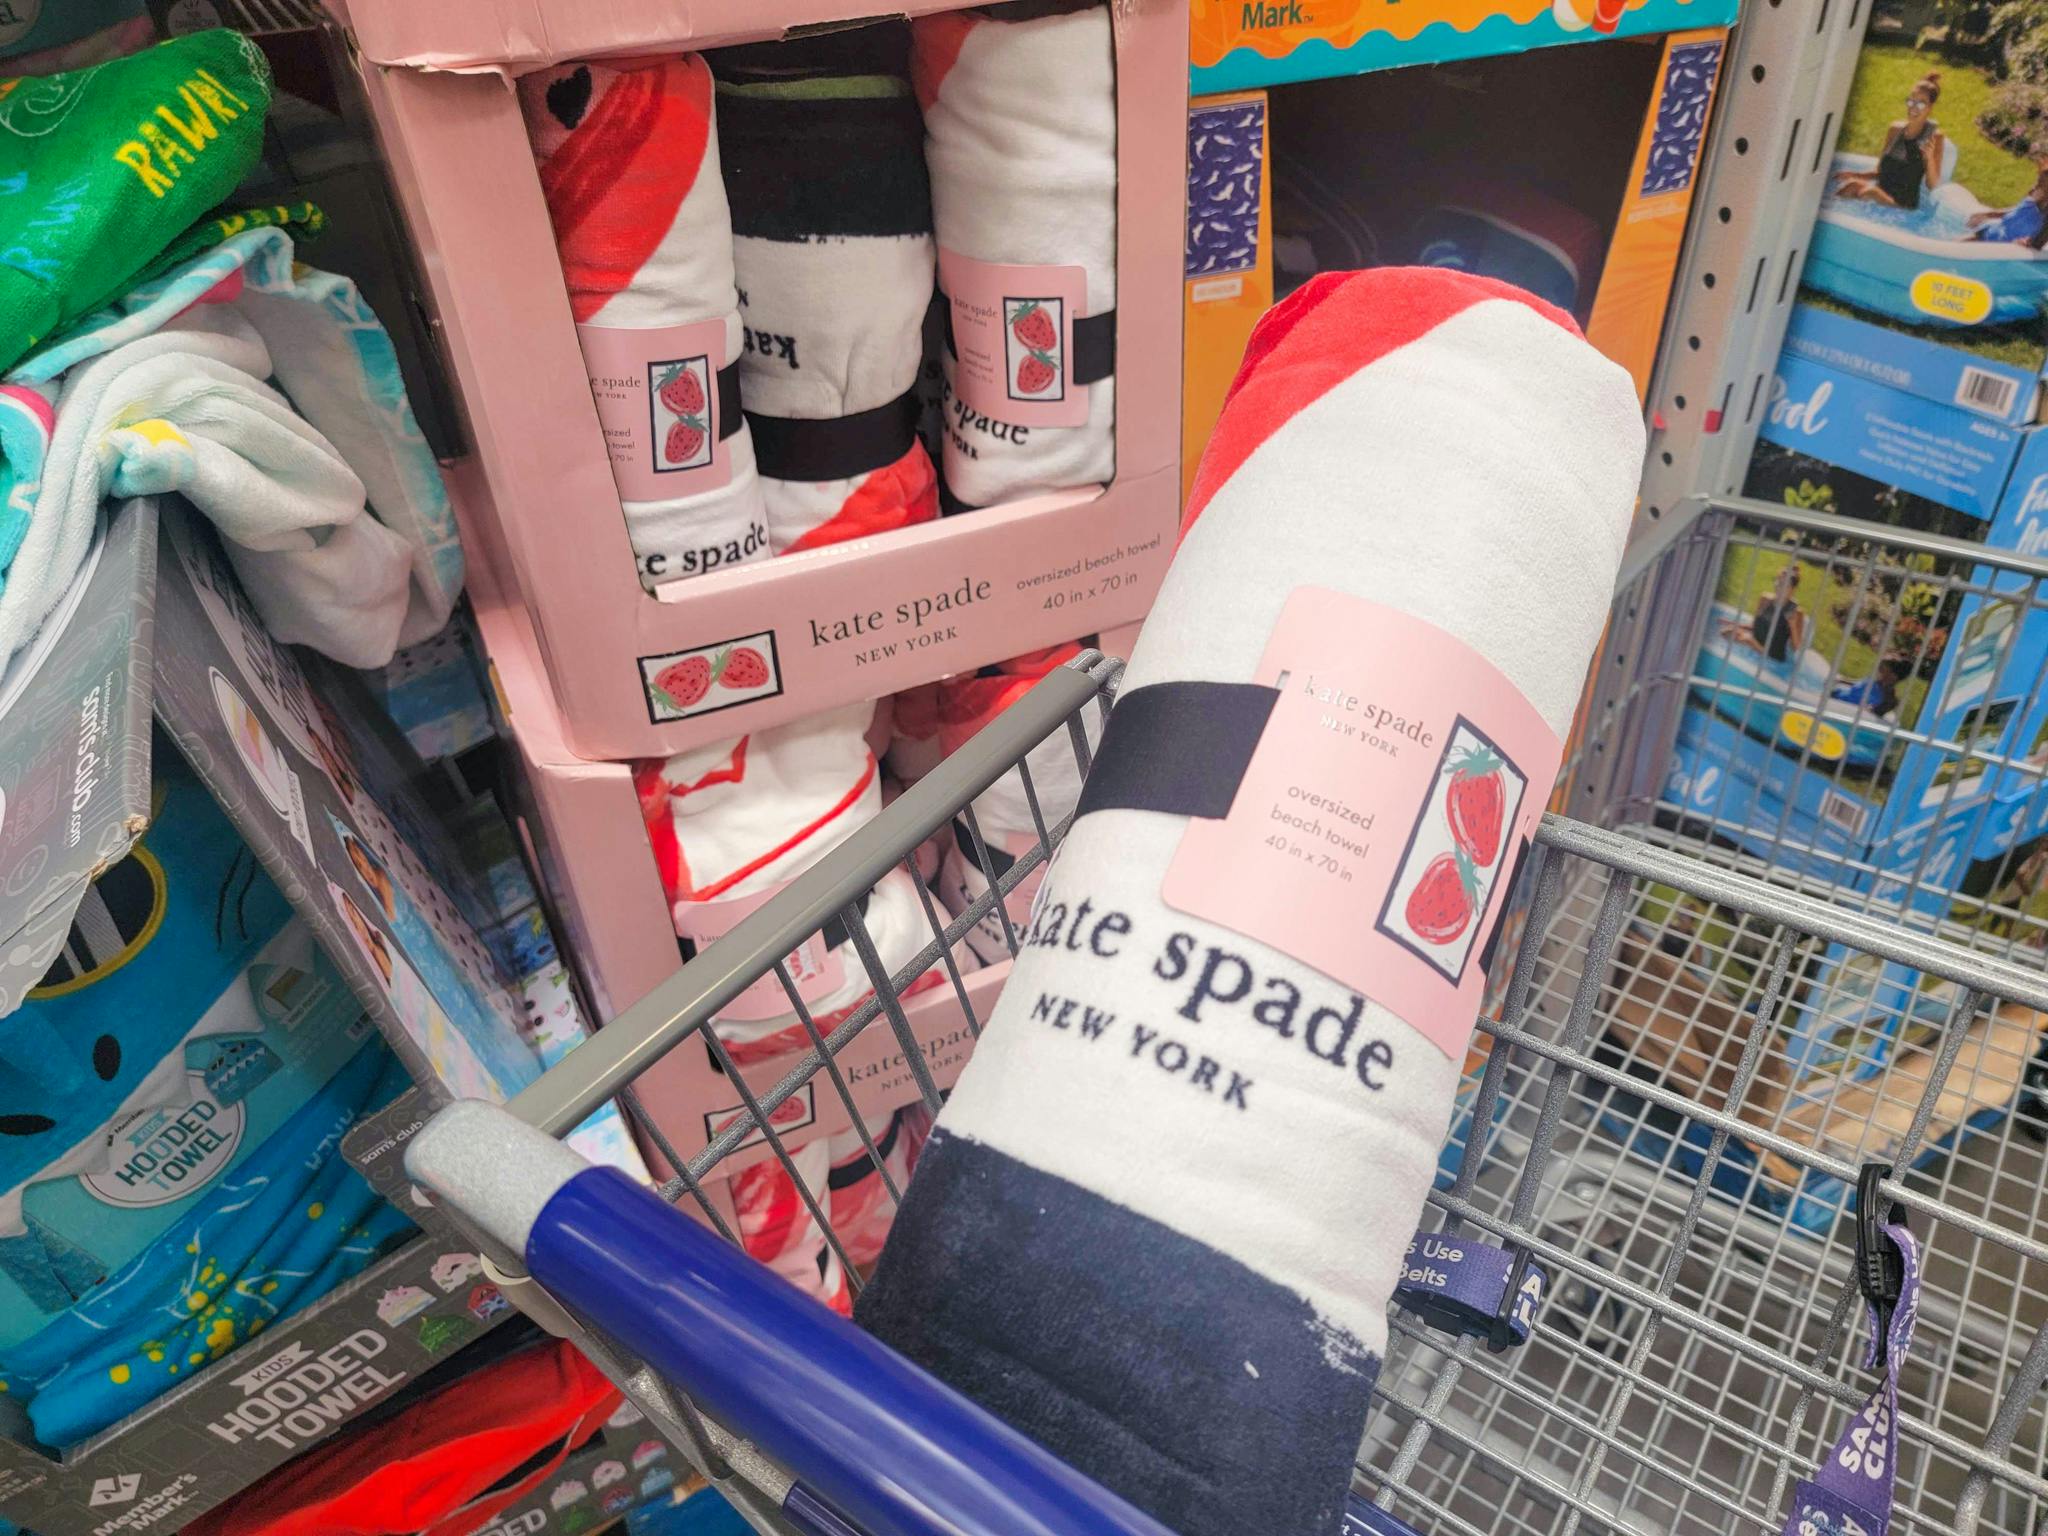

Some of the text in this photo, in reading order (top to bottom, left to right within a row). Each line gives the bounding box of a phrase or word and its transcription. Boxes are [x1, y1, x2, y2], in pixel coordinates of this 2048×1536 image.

[1931, 297, 1965, 313] LONG
[1945, 284, 1974, 301] FEET
[743, 326, 799, 369] kat
[602, 376, 641, 389] spade
[682, 522, 767, 575] spade
[1016, 534, 1161, 591] oversized beach towel
[808, 577, 992, 647] kate spade
[1043, 571, 1138, 611] 40 in x 70 in
[855, 626, 959, 666] NEW YORK
[1304, 676, 1434, 749] kate spade
[1320, 714, 1399, 758] NEW YORK
[1271, 804, 1370, 859] beach towel
[1288, 785, 1376, 831] oversized
[1265, 833, 1353, 883] 40 in x 70 in
[1027, 886, 1132, 958] kate
[1152, 931, 1394, 1091] spade
[929, 1054, 964, 1073] ORK
[1030, 992, 1253, 1111] NEW YORK
[115, 1100, 217, 1186] HOODED
[146, 1128, 232, 1190] TOWEL
[361, 1137, 397, 1165] sam's
[396, 1121, 423, 1141] club
[1423, 1239, 1464, 1262] Use
[206, 1329, 388, 1444] HOODED
[252, 1354, 293, 1382] KIDS
[255, 1366, 408, 1449] TOWEL
[1864, 1393, 1890, 1480] CLU
[92, 1473, 198, 1536] Member's
